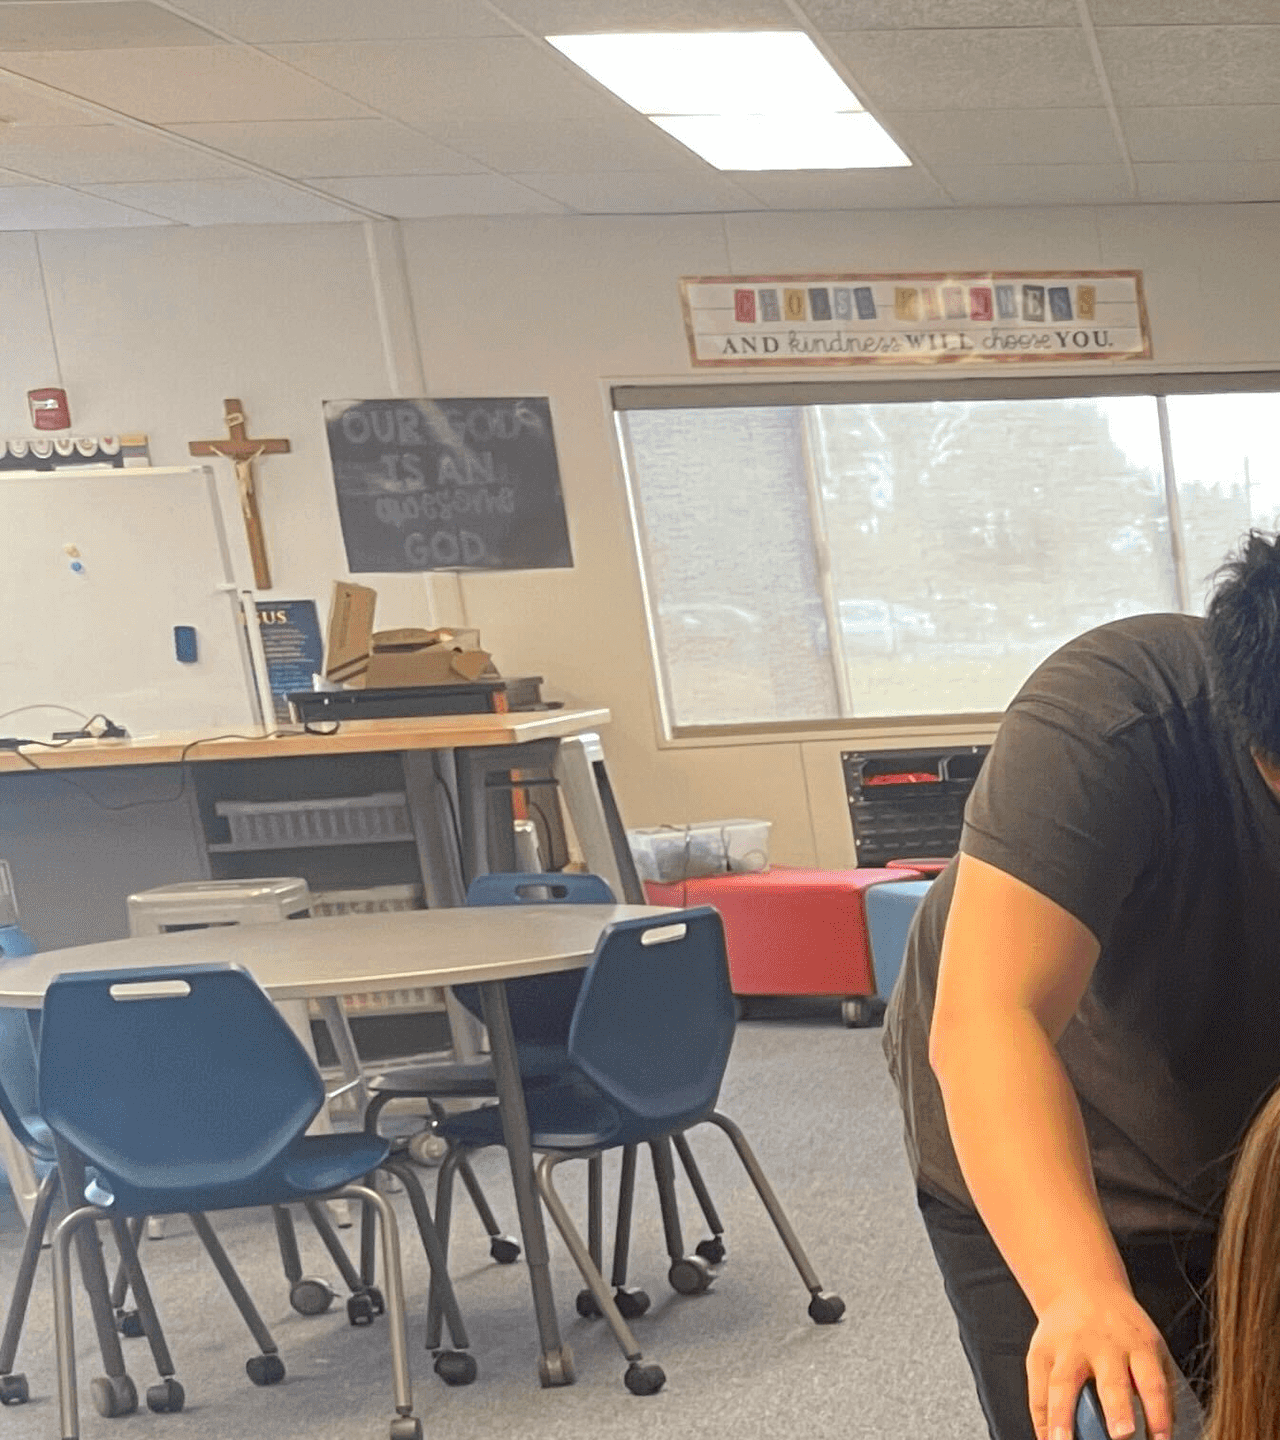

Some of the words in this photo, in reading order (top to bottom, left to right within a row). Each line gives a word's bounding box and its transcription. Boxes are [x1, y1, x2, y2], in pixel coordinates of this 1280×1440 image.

[723, 336, 780, 354] AND
[788, 330, 902, 354] kindness
[905, 332, 974, 352] WILL
[982, 328, 1052, 351] choose
[342, 408, 425, 445] OUR
[380, 453, 426, 491] IS
[437, 451, 496, 486] AN
[404, 530, 485, 565] GOD
